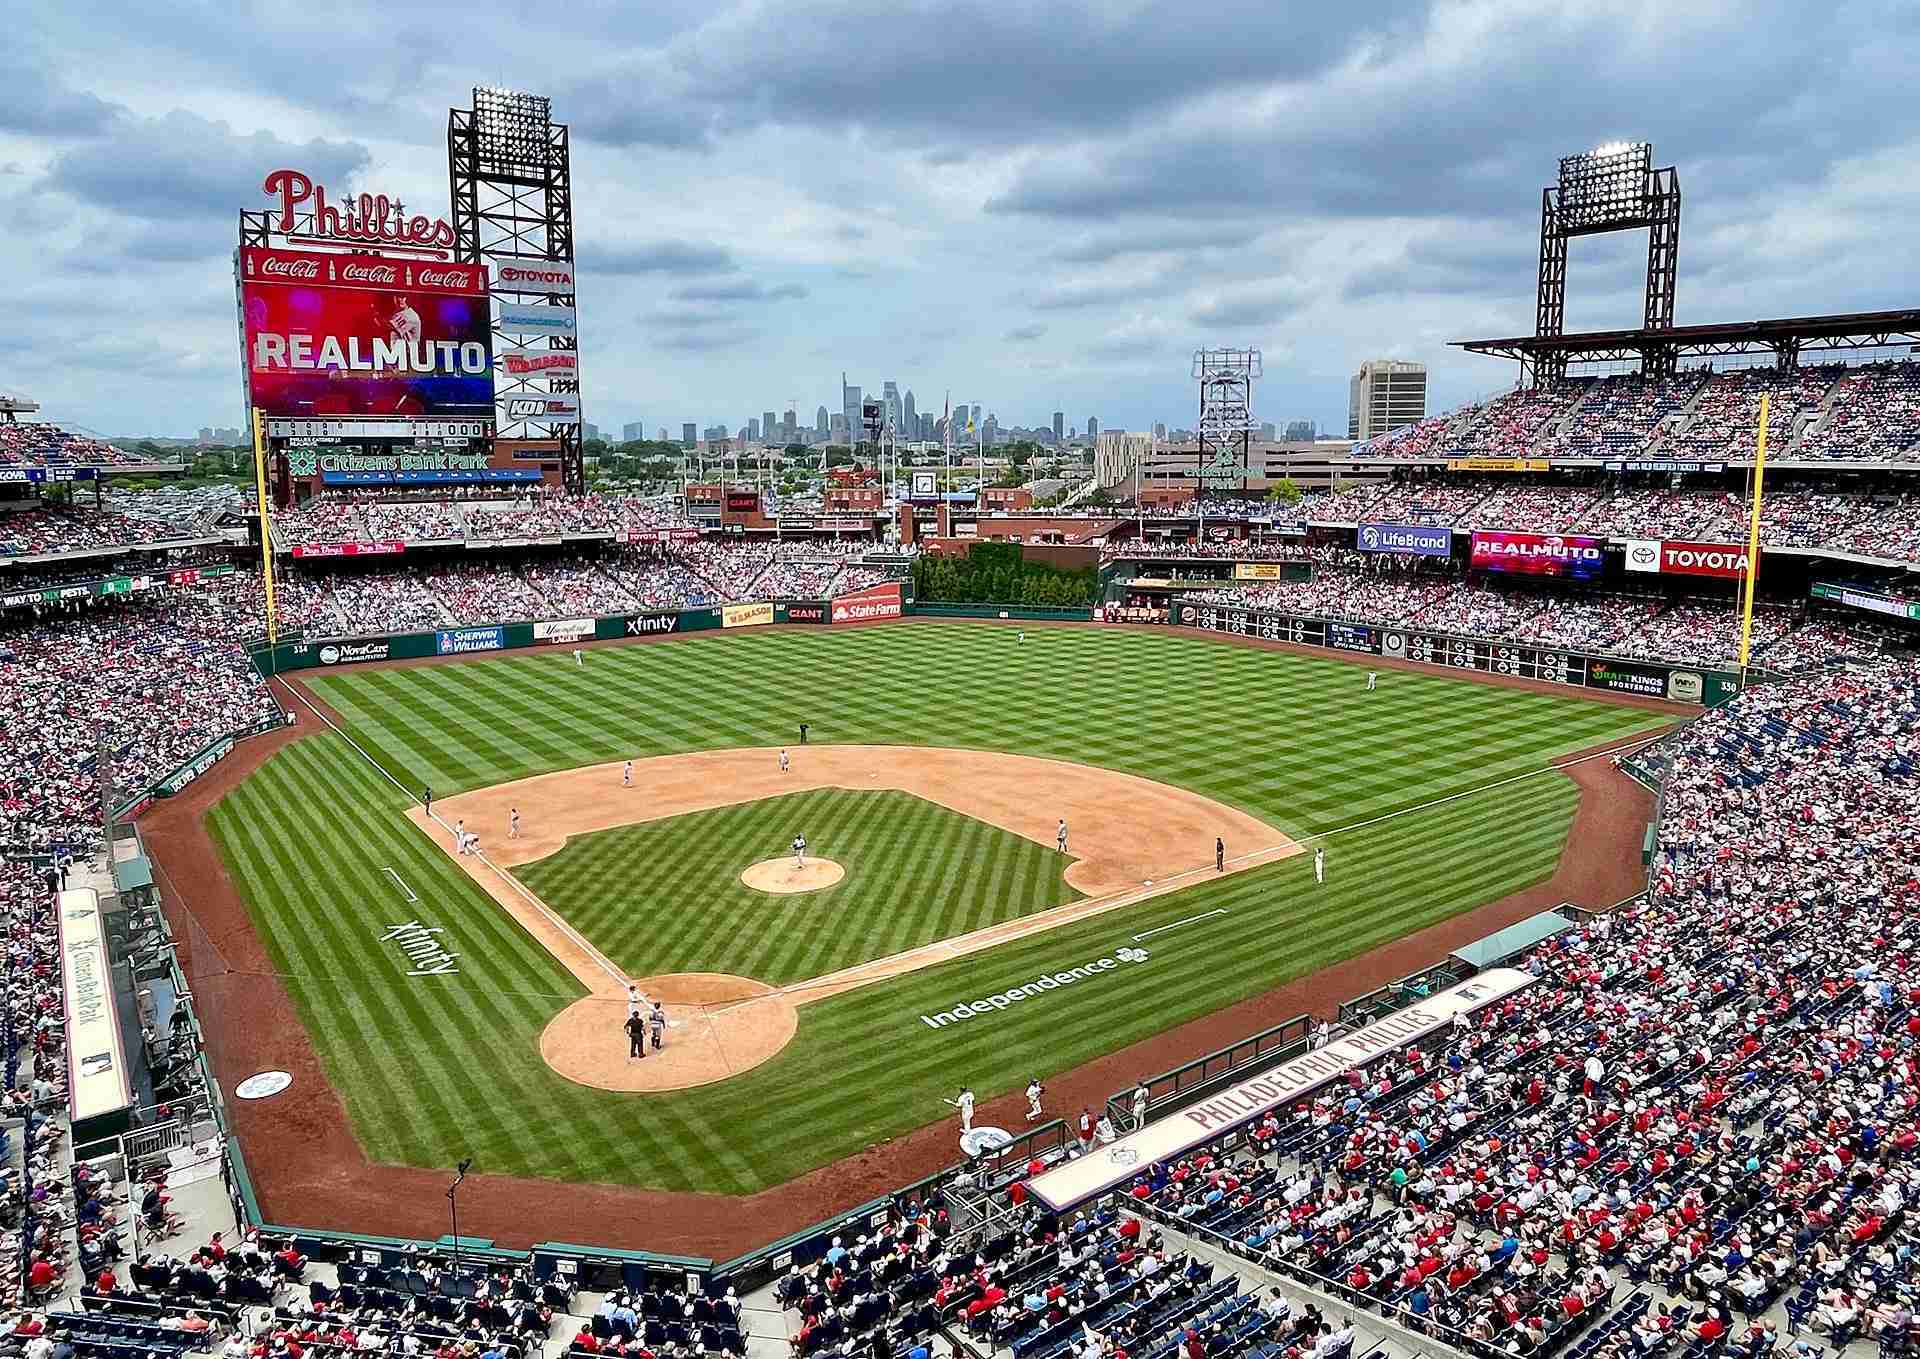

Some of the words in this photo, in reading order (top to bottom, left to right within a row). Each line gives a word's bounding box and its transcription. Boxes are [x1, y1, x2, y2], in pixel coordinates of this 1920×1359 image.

[264, 170, 457, 248] Phillies
[518, 269, 571, 284] TOYOTA
[254, 332, 487, 375] REALMUTO
[320, 453, 398, 472] Citizens
[400, 452, 448, 471] Bank
[449, 452, 488, 470] Park
[630, 533, 657, 541] TOYOTA
[671, 531, 698, 539] TOYOTA
[1382, 532, 1446, 549] LifeBrand
[1474, 541, 1600, 560] REALMUTO
[1665, 549, 1750, 570] TOYOTA
[788, 608, 823, 619] GIANT
[626, 613, 677, 635] xfinity
[453, 630, 498, 642] SHERWIN
[293, 645, 308, 654] 334
[340, 643, 389, 657] NovaCare
[1720, 681, 1737, 692] 330
[379, 920, 461, 976] xfinity
[920, 956, 1118, 1029] Independence
[1184, 1050, 1353, 1130] PHILADELPHIA
[1346, 1008, 1439, 1054] PHILLIES
